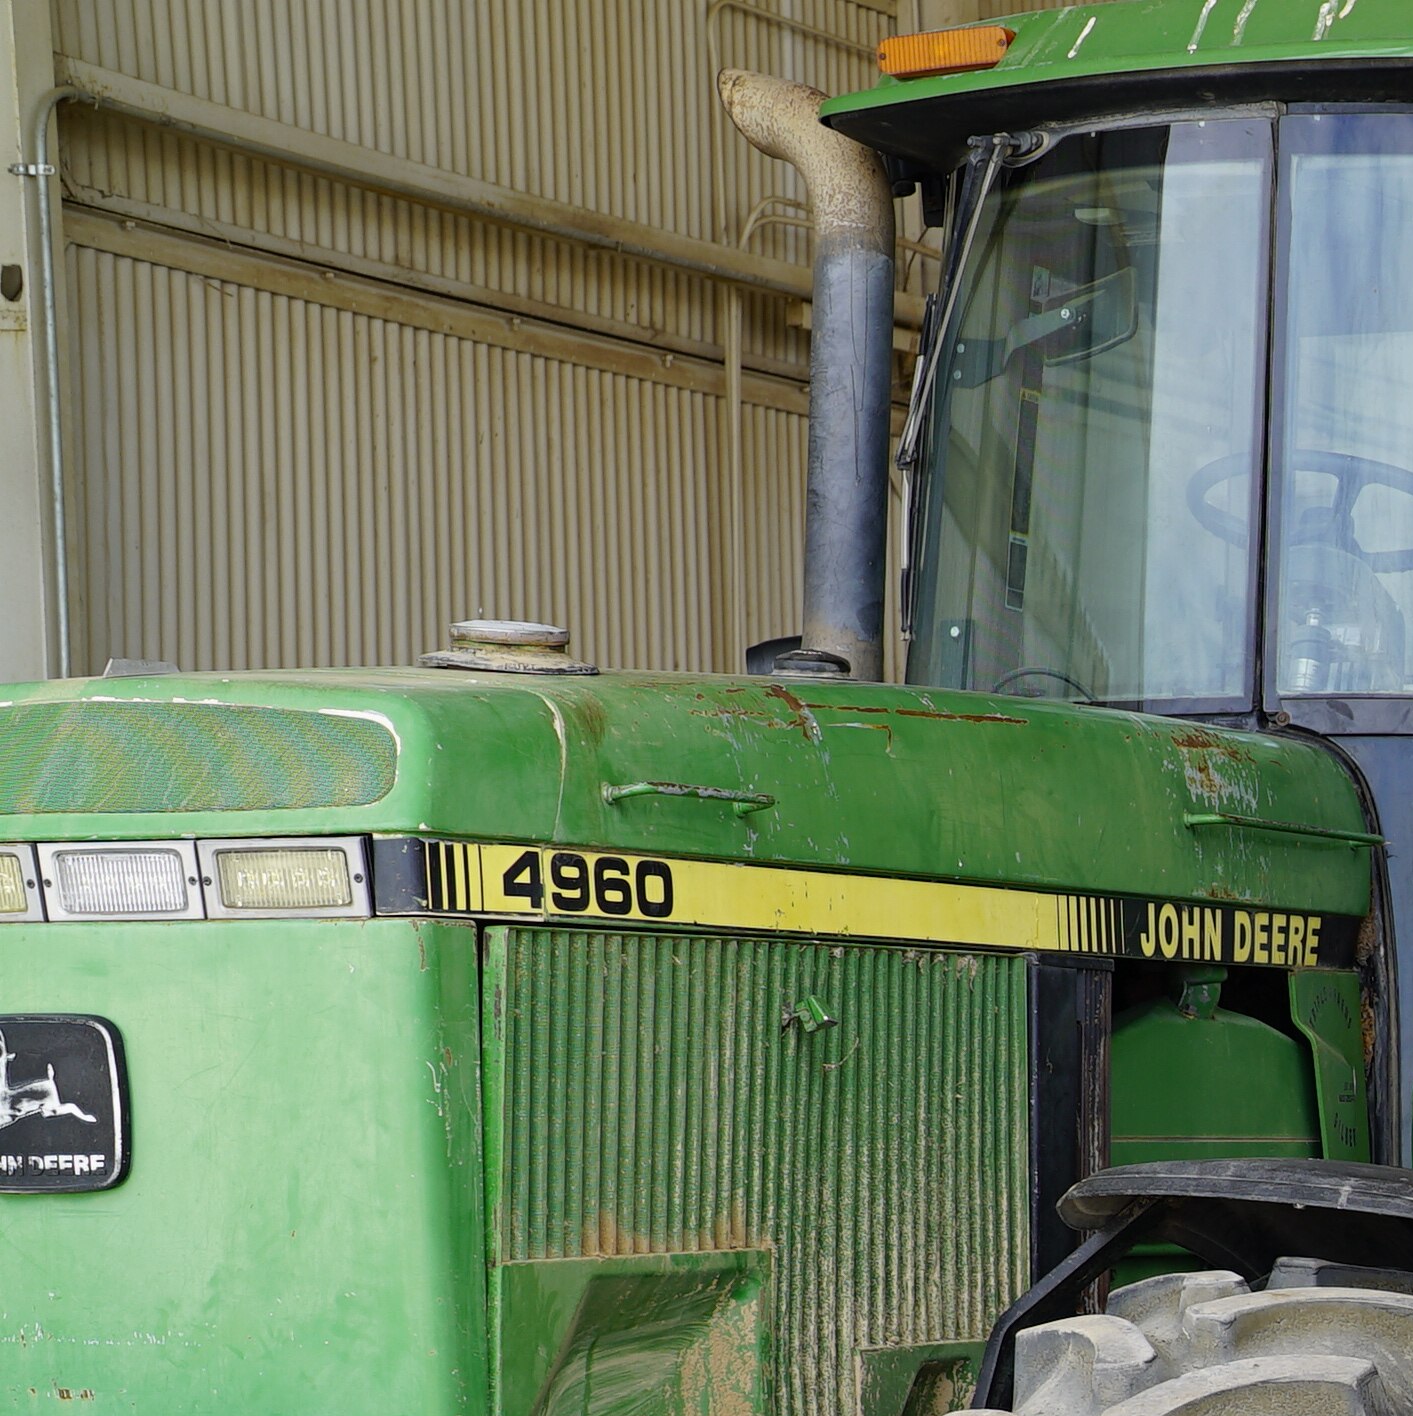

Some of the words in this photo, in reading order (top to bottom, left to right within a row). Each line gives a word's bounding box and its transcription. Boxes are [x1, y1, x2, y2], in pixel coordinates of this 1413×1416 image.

[502, 850, 674, 919] 4960
[1140, 902, 1222, 961] JOHN
[1233, 910, 1322, 967] DEERE
[27, 1153, 107, 1177] DEERE
